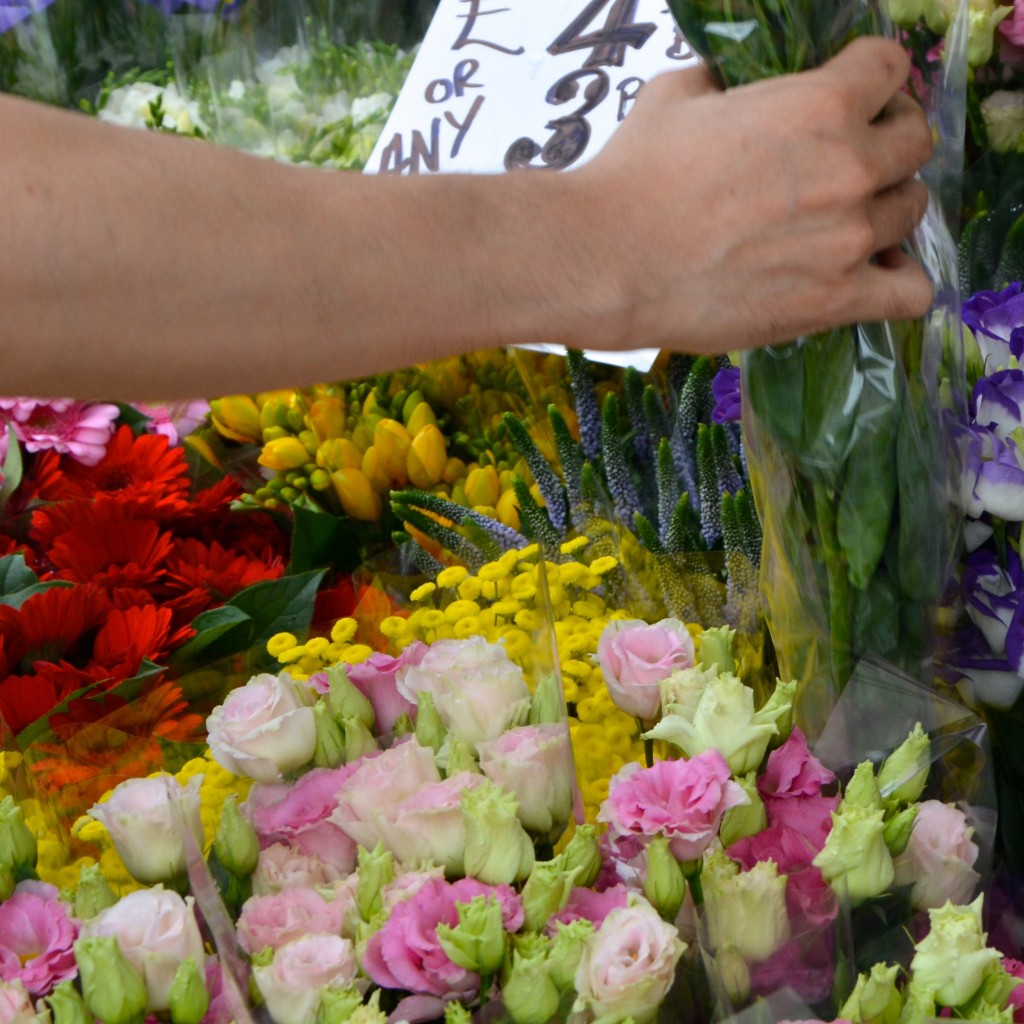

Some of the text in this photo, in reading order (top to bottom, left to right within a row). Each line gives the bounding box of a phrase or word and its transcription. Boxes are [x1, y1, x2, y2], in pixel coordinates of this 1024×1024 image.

[425, 59, 485, 103] OR
[503, 68, 610, 172] 3
[378, 95, 485, 175] ANY
